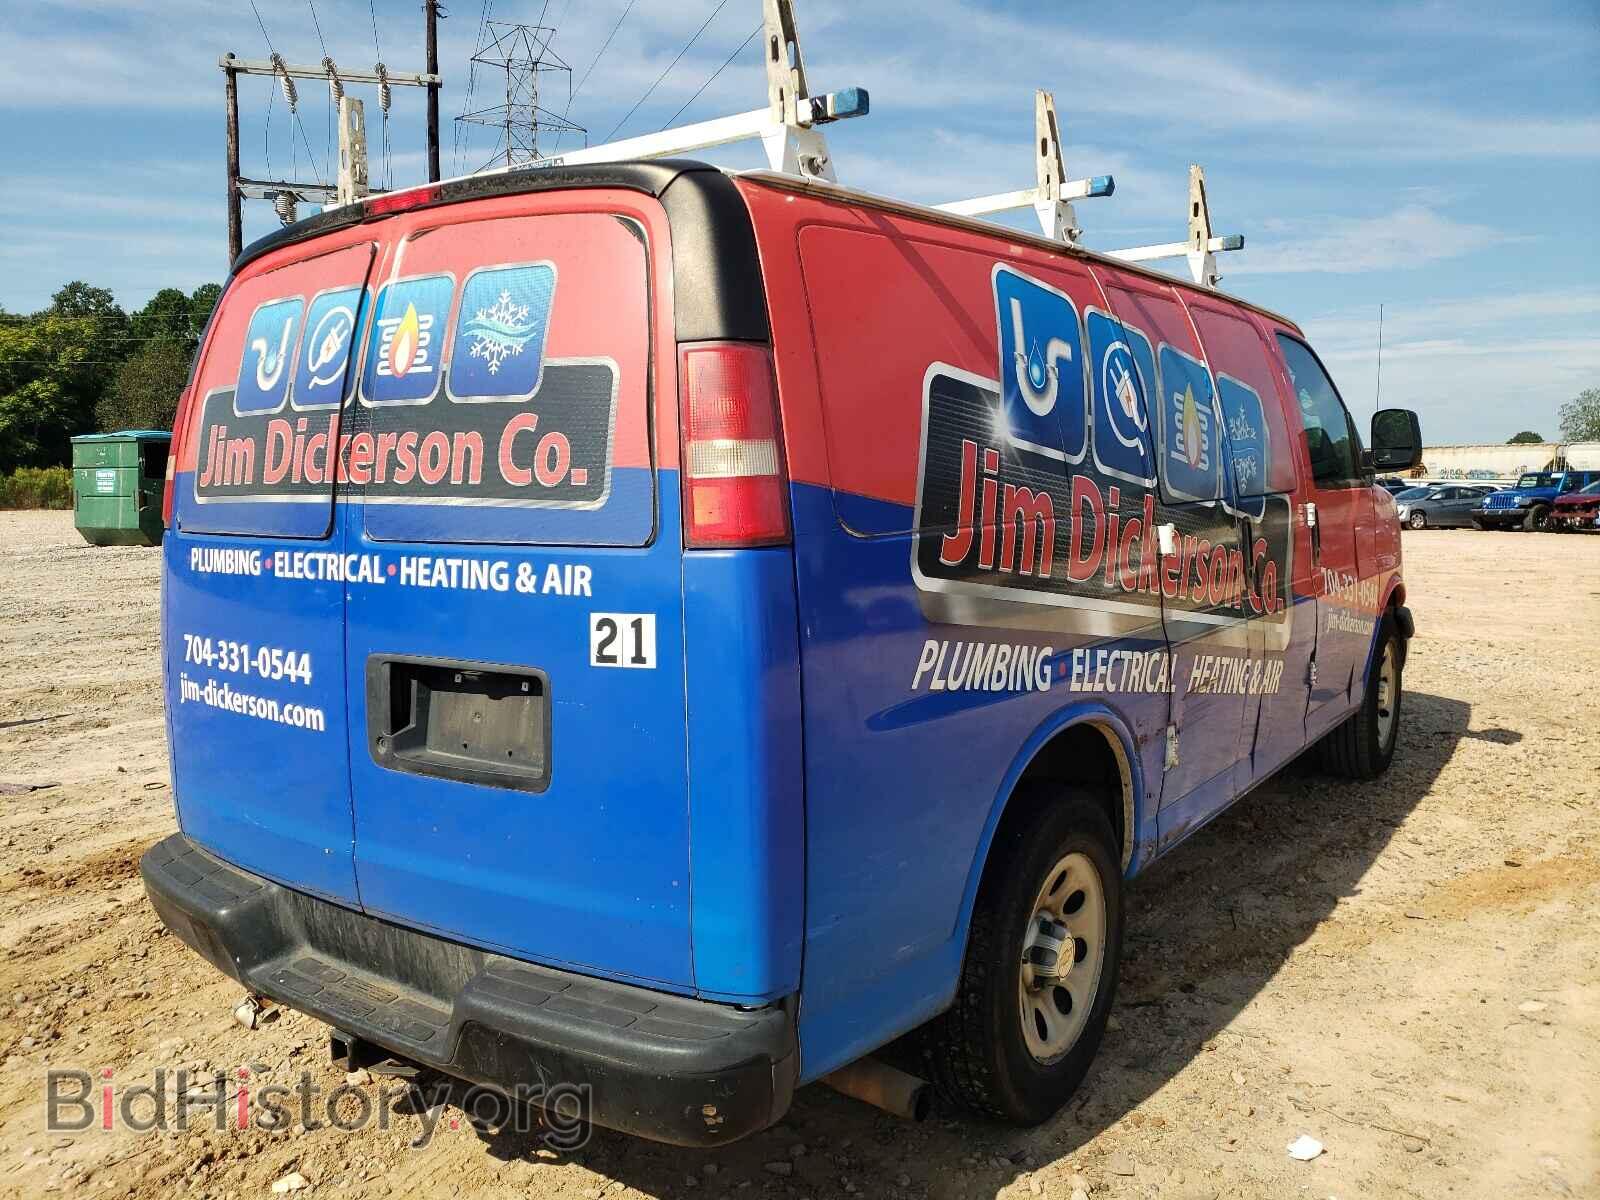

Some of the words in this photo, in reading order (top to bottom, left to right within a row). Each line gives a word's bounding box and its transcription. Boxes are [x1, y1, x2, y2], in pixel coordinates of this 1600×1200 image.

[200, 424, 255, 487] Jim
[263, 413, 484, 486] Dickerson
[499, 412, 589, 487] Co.
[939, 439, 1057, 576] Jim
[1066, 474, 1246, 609] Dickerson
[1249, 537, 1284, 615] Co.
[190, 547, 261, 576] PLUMBING
[274, 551, 386, 584] ELECTRICAL
[399, 555, 509, 591] HEATING
[515, 562, 536, 593] &
[542, 563, 593, 597] AIR
[183, 633, 312, 685] 704-331-0544
[594, 617, 648, 665] 21
[911, 639, 1053, 692] PLUMBING
[1069, 648, 1178, 693] ELECTRICAL
[1187, 655, 1250, 694] HEATING
[1262, 660, 1284, 695] AIR
[180, 671, 325, 732] jim-dickerson.com
